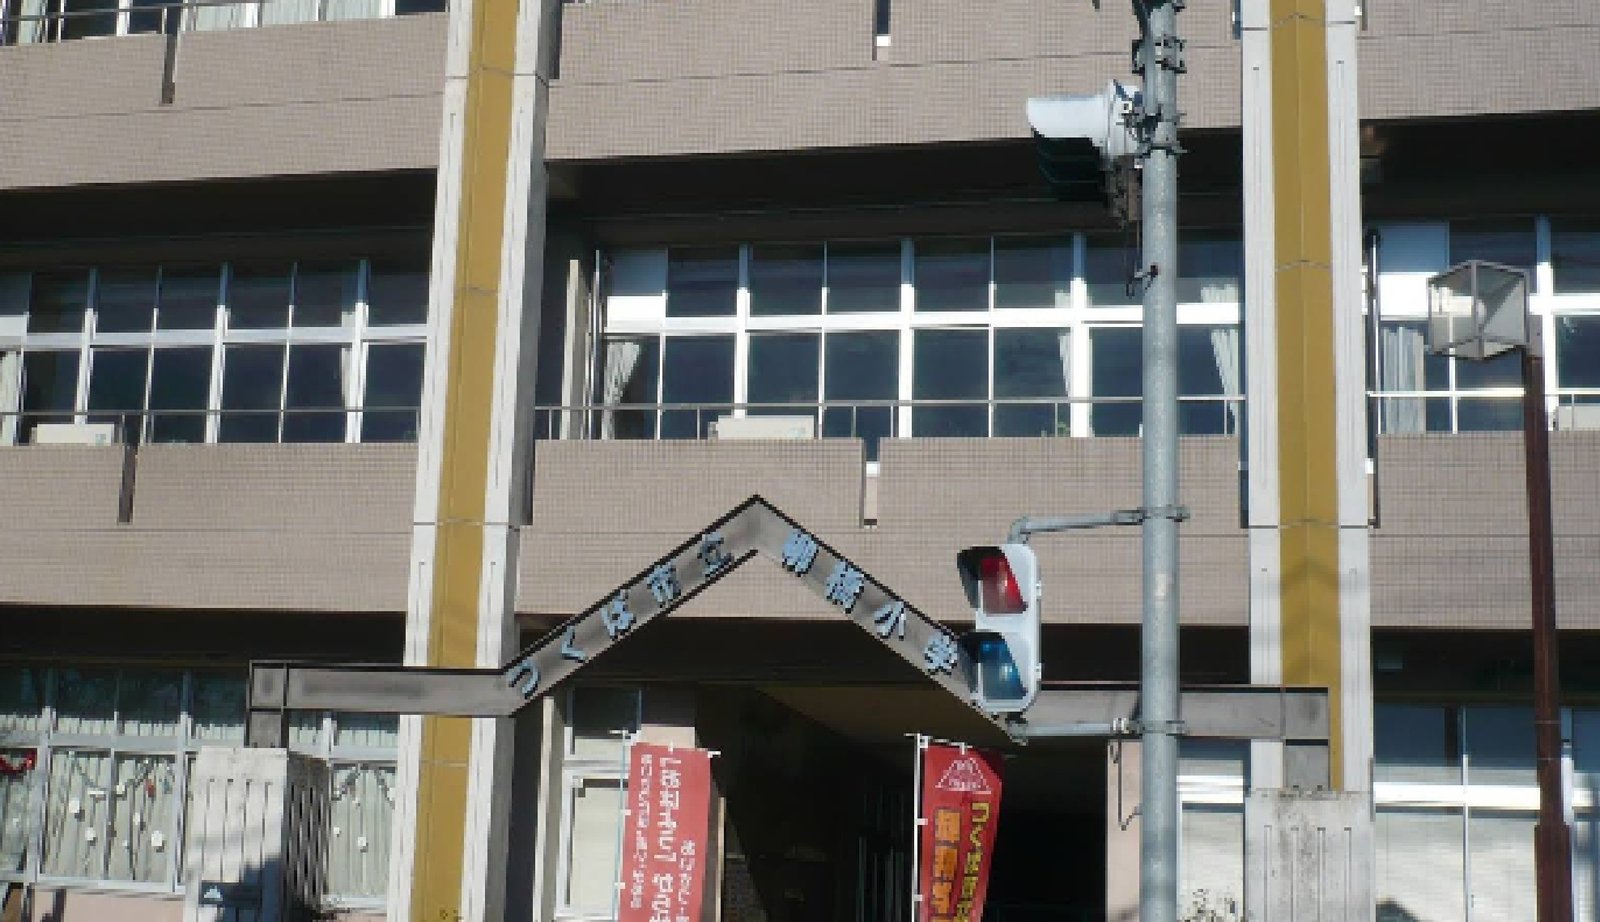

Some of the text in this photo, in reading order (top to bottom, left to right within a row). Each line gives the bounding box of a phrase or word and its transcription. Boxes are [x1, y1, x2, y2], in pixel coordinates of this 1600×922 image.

[508, 530, 959, 699] つくば市立 柳橋小学
